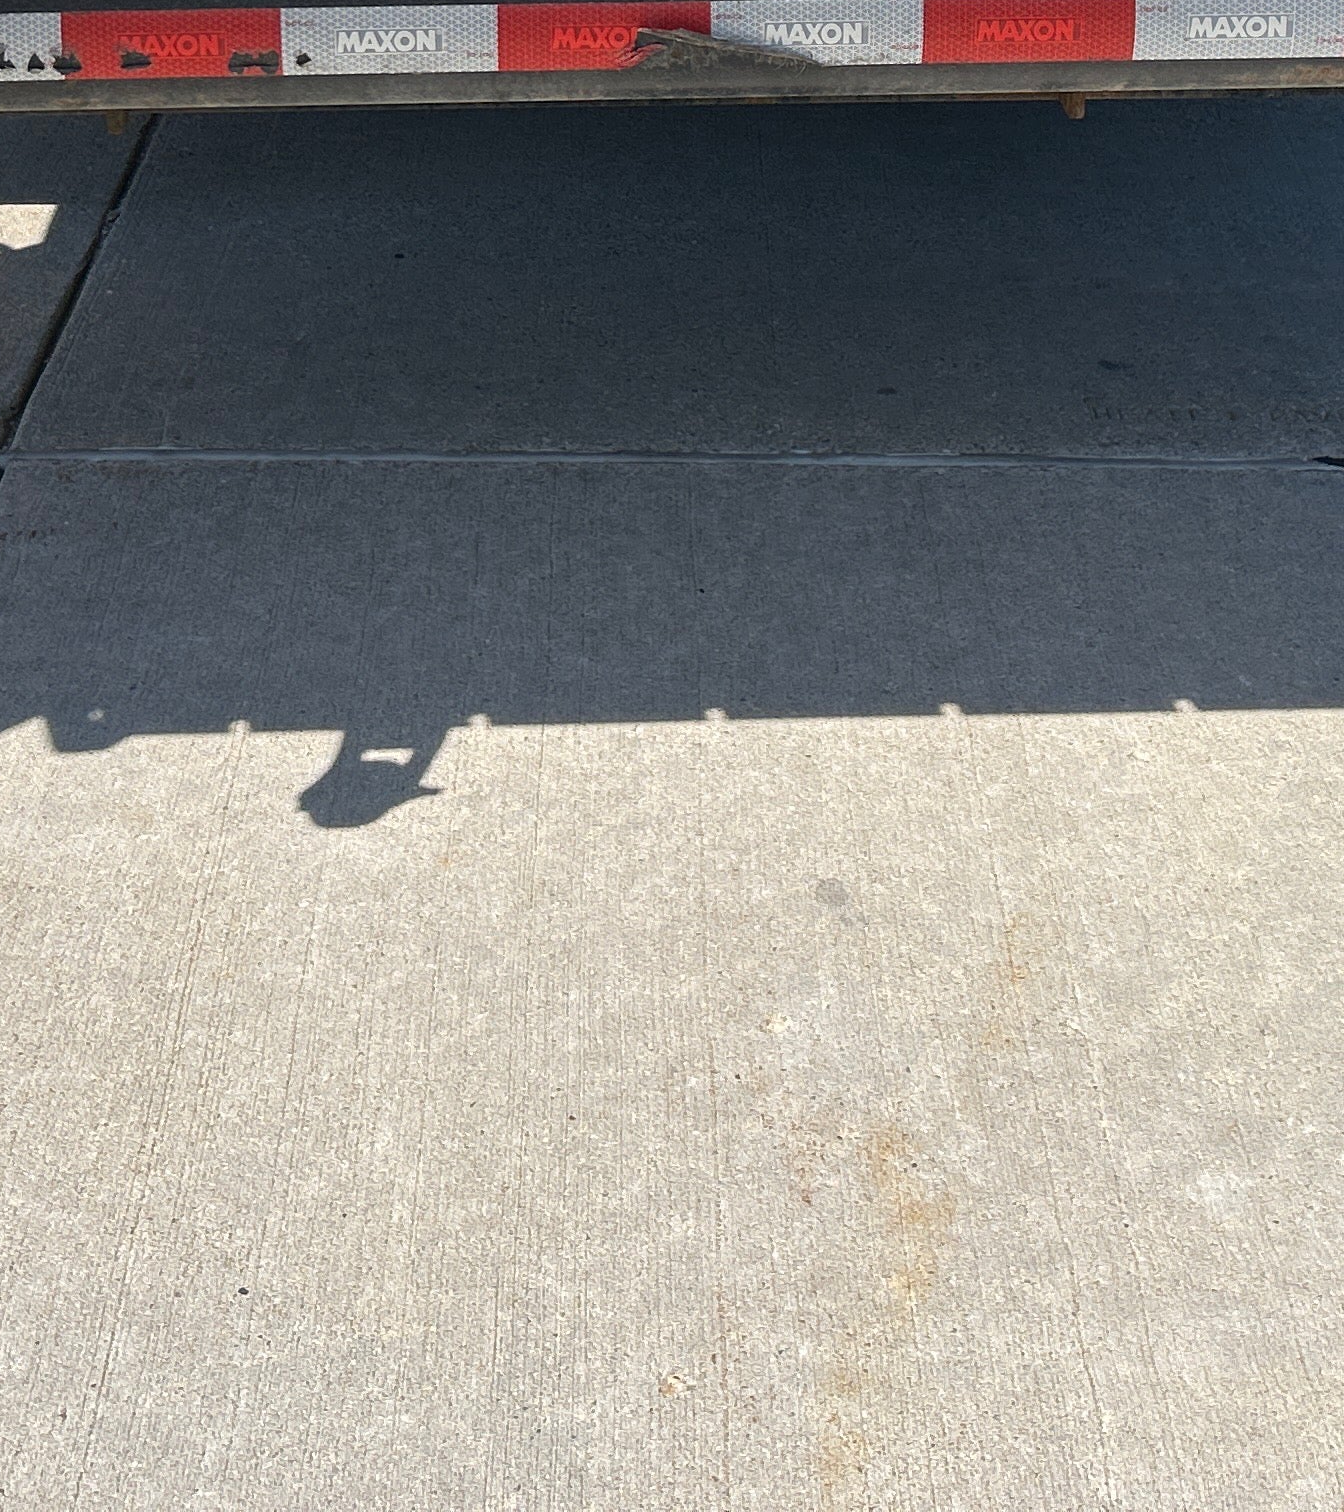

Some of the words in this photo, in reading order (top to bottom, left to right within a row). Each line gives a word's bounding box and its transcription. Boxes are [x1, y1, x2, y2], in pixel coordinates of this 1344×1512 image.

[762, 21, 863, 46] MAXON
[975, 18, 1077, 43] MAXON
[1186, 14, 1290, 39] MAXON
[117, 34, 220, 57] MAXON
[335, 29, 439, 54] MAXON
